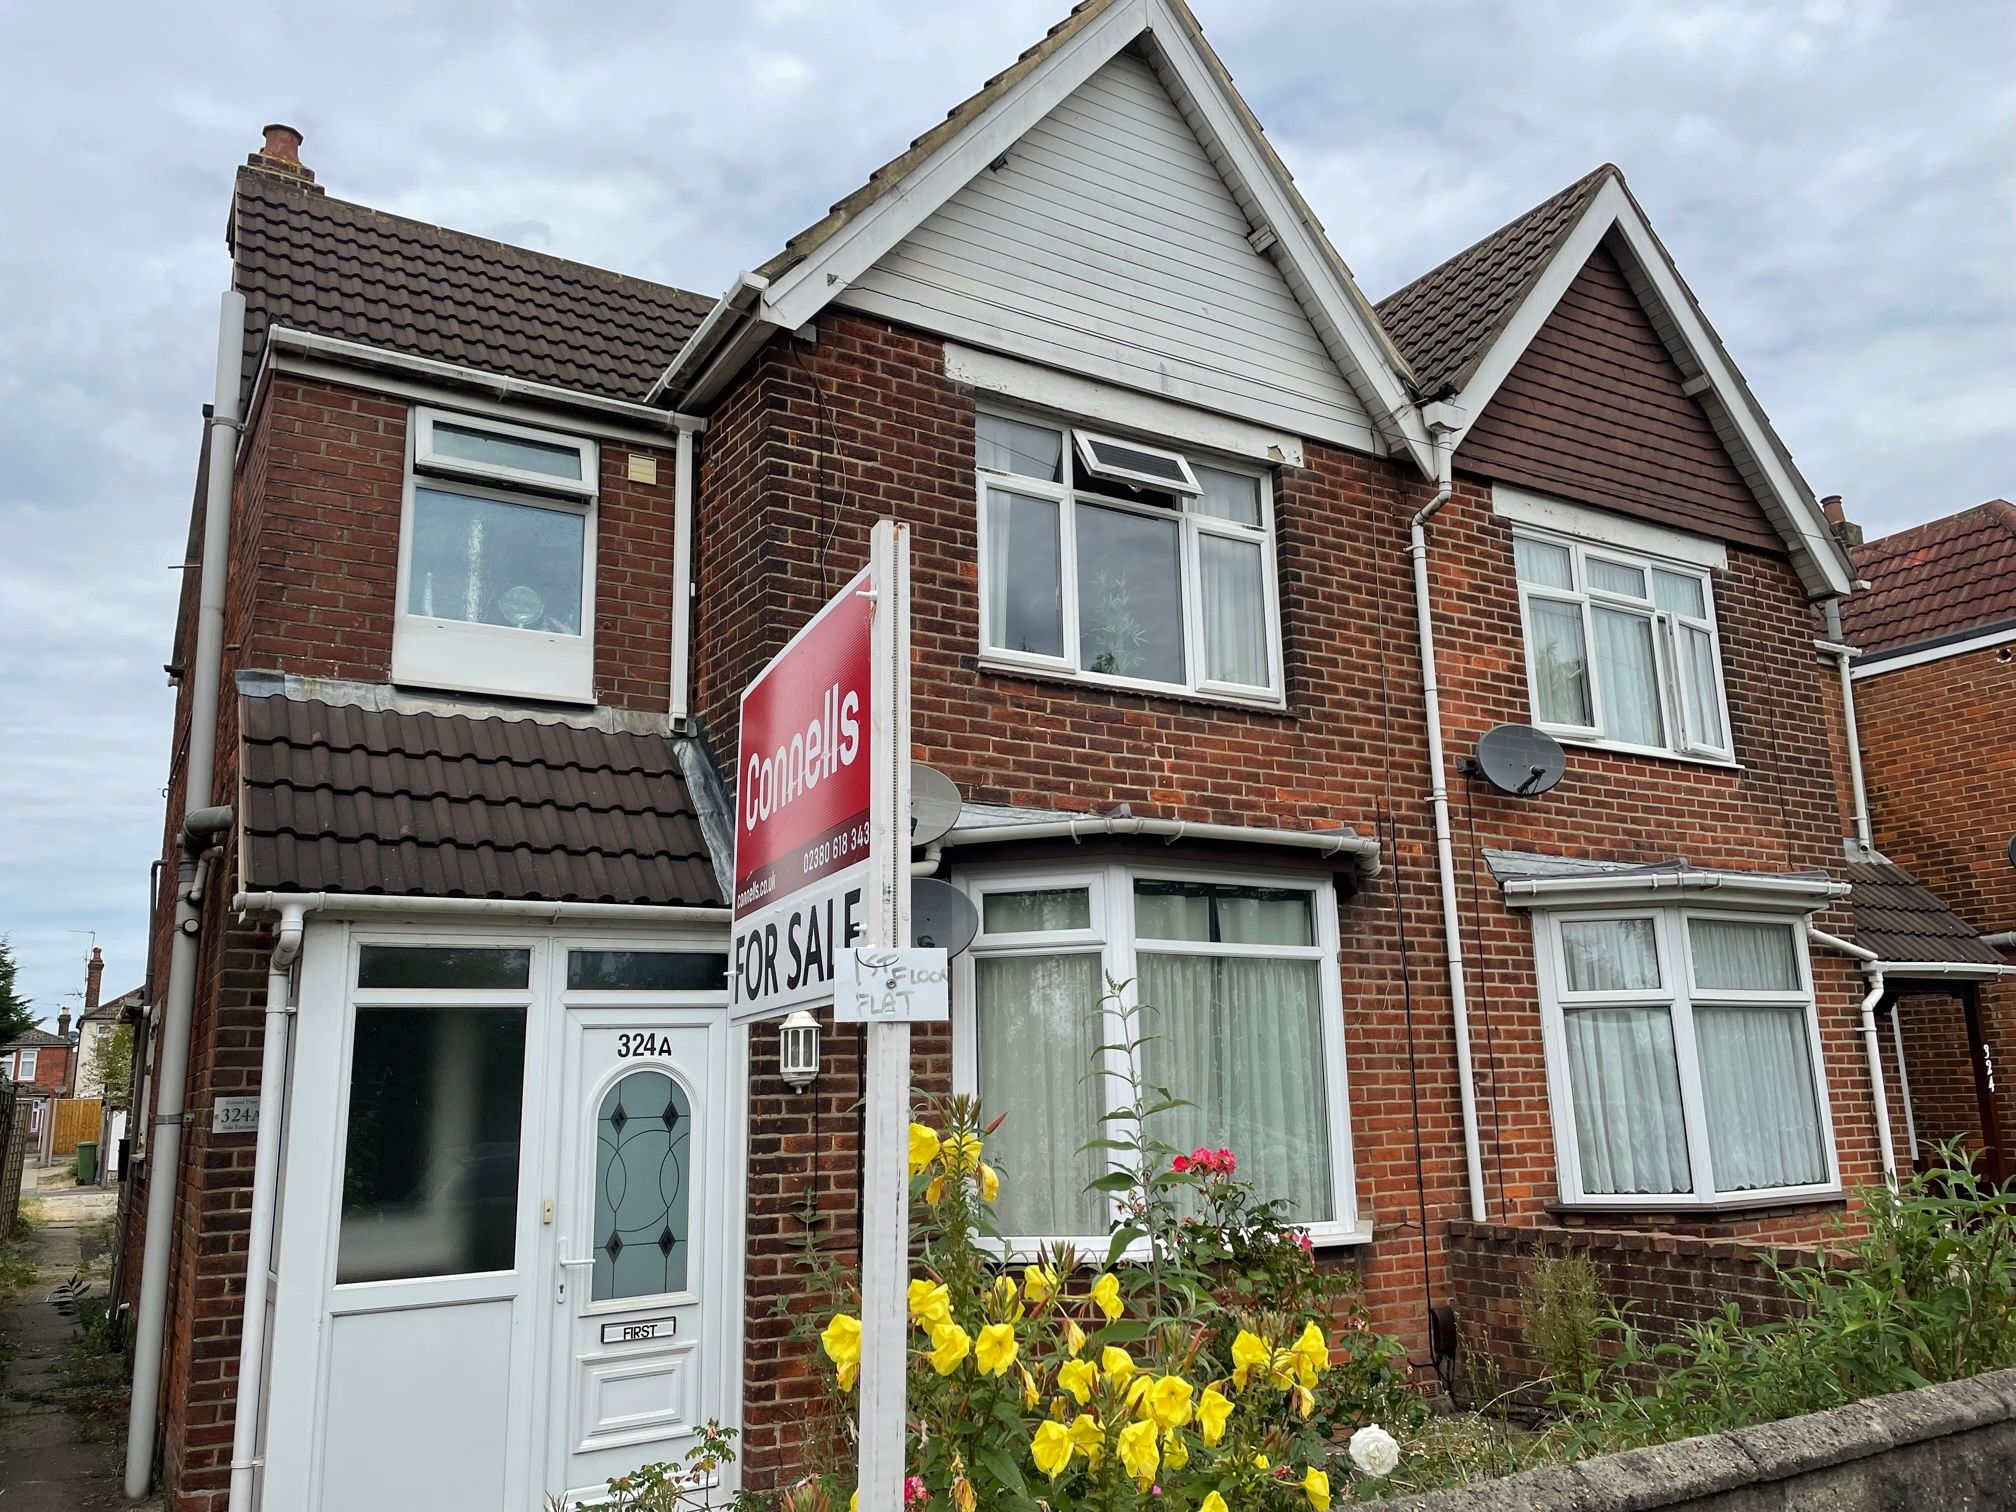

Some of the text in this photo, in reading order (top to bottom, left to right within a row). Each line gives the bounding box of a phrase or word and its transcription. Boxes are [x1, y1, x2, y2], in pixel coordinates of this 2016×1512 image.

[746, 682, 860, 831] Connells
[803, 821, 870, 874] 02380 618 343
[737, 869, 776, 909] connells.co.uk
[735, 887, 861, 1005] FOR SALE
[856, 990, 915, 1017] FLAT
[617, 1032, 672, 1058] 324A
[1983, 1043, 1995, 1093] 324
[623, 1324, 658, 1340] FIRST
